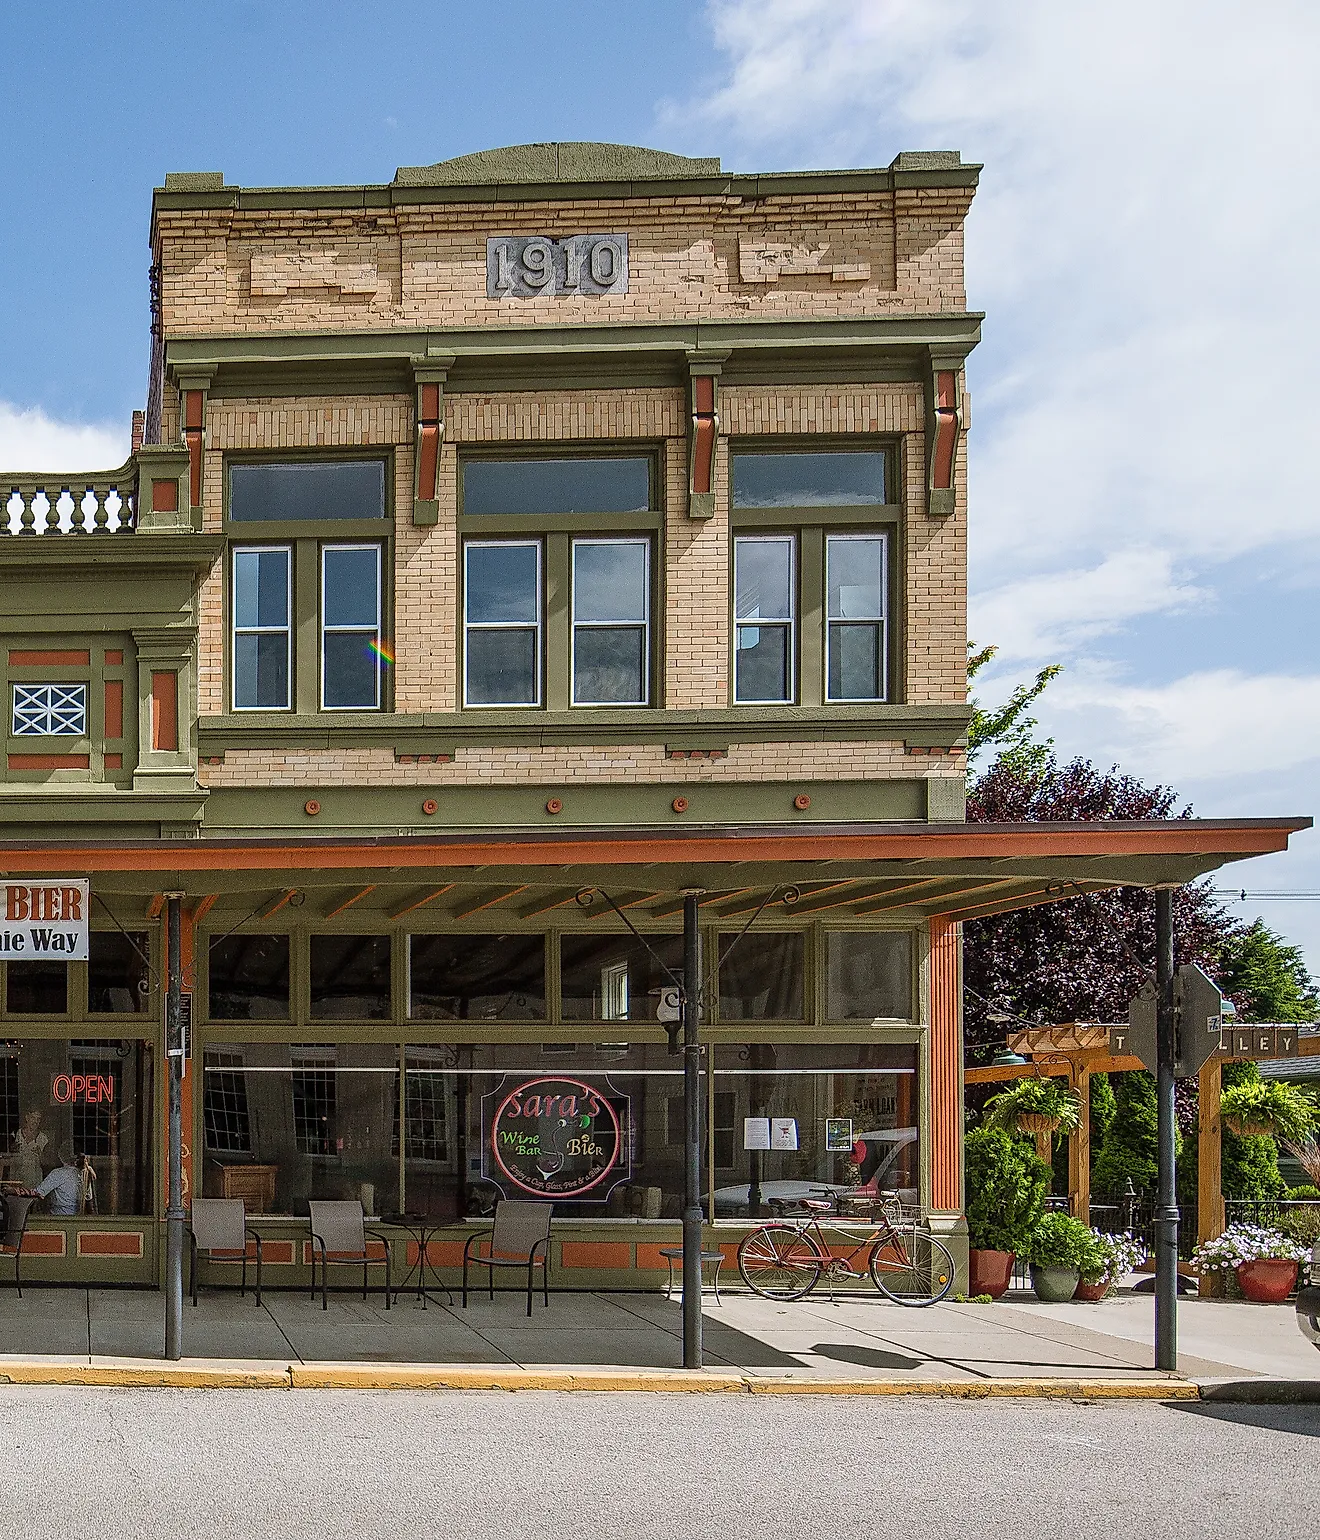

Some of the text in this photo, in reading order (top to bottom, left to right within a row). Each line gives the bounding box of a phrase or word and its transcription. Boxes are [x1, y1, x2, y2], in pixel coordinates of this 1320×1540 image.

[495, 240, 622, 289] 1910
[5, 886, 82, 921] BIER
[30, 929, 79, 954] Way
[53, 1074, 114, 1103] OPEN
[507, 1087, 601, 1118] Sara's
[500, 1131, 540, 1145] Wine
[510, 1164, 527, 1181] Enjoy
